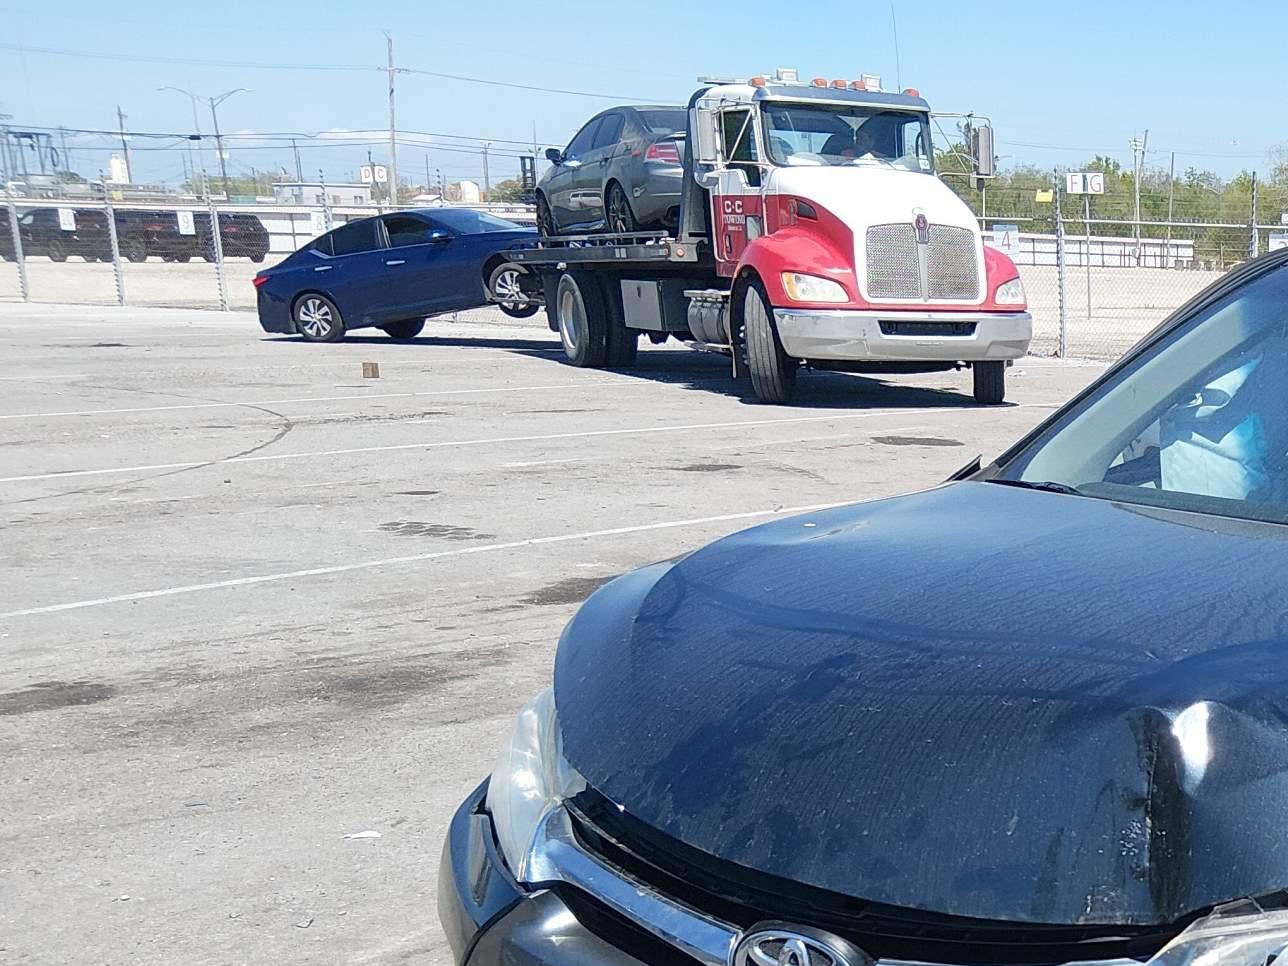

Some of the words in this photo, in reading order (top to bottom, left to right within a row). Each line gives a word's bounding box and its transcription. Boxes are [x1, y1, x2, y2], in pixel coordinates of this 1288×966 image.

[363, 168, 371, 179] D
[377, 168, 385, 179] C
[1070, 174, 1078, 192] F
[1090, 174, 1102, 192] G
[1001, 231, 1011, 250] 4
